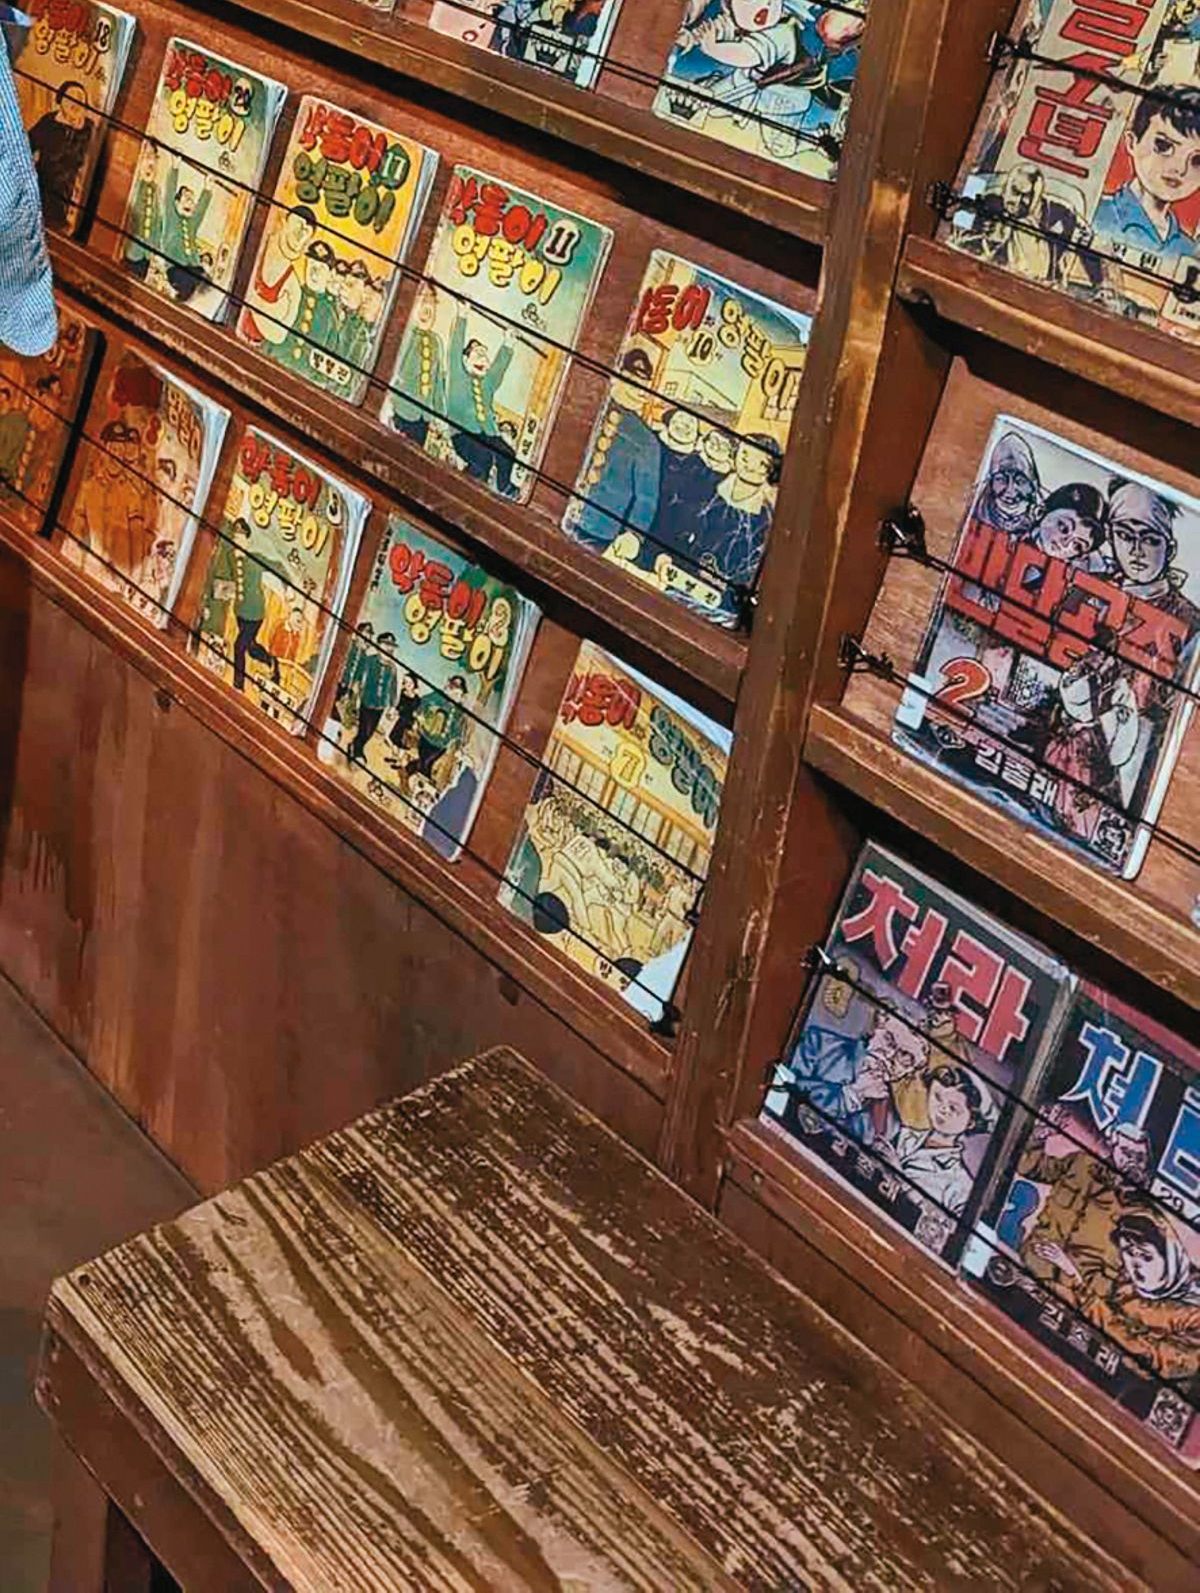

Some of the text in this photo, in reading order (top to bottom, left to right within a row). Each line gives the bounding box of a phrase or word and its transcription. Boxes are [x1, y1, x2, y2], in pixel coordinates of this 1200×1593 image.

[294, 152, 396, 234] 영팔이
[383, 154, 405, 179] 17
[451, 224, 562, 305] 영팔이
[550, 225, 574, 258] 11
[690, 331, 712, 360] 10
[248, 488, 331, 558] 영팔이
[389, 543, 484, 621] 약동이
[404, 594, 504, 683] 영팔이
[934, 656, 993, 709] 2
[620, 751, 637, 779] 7
[973, 740, 1060, 808] 김종래
